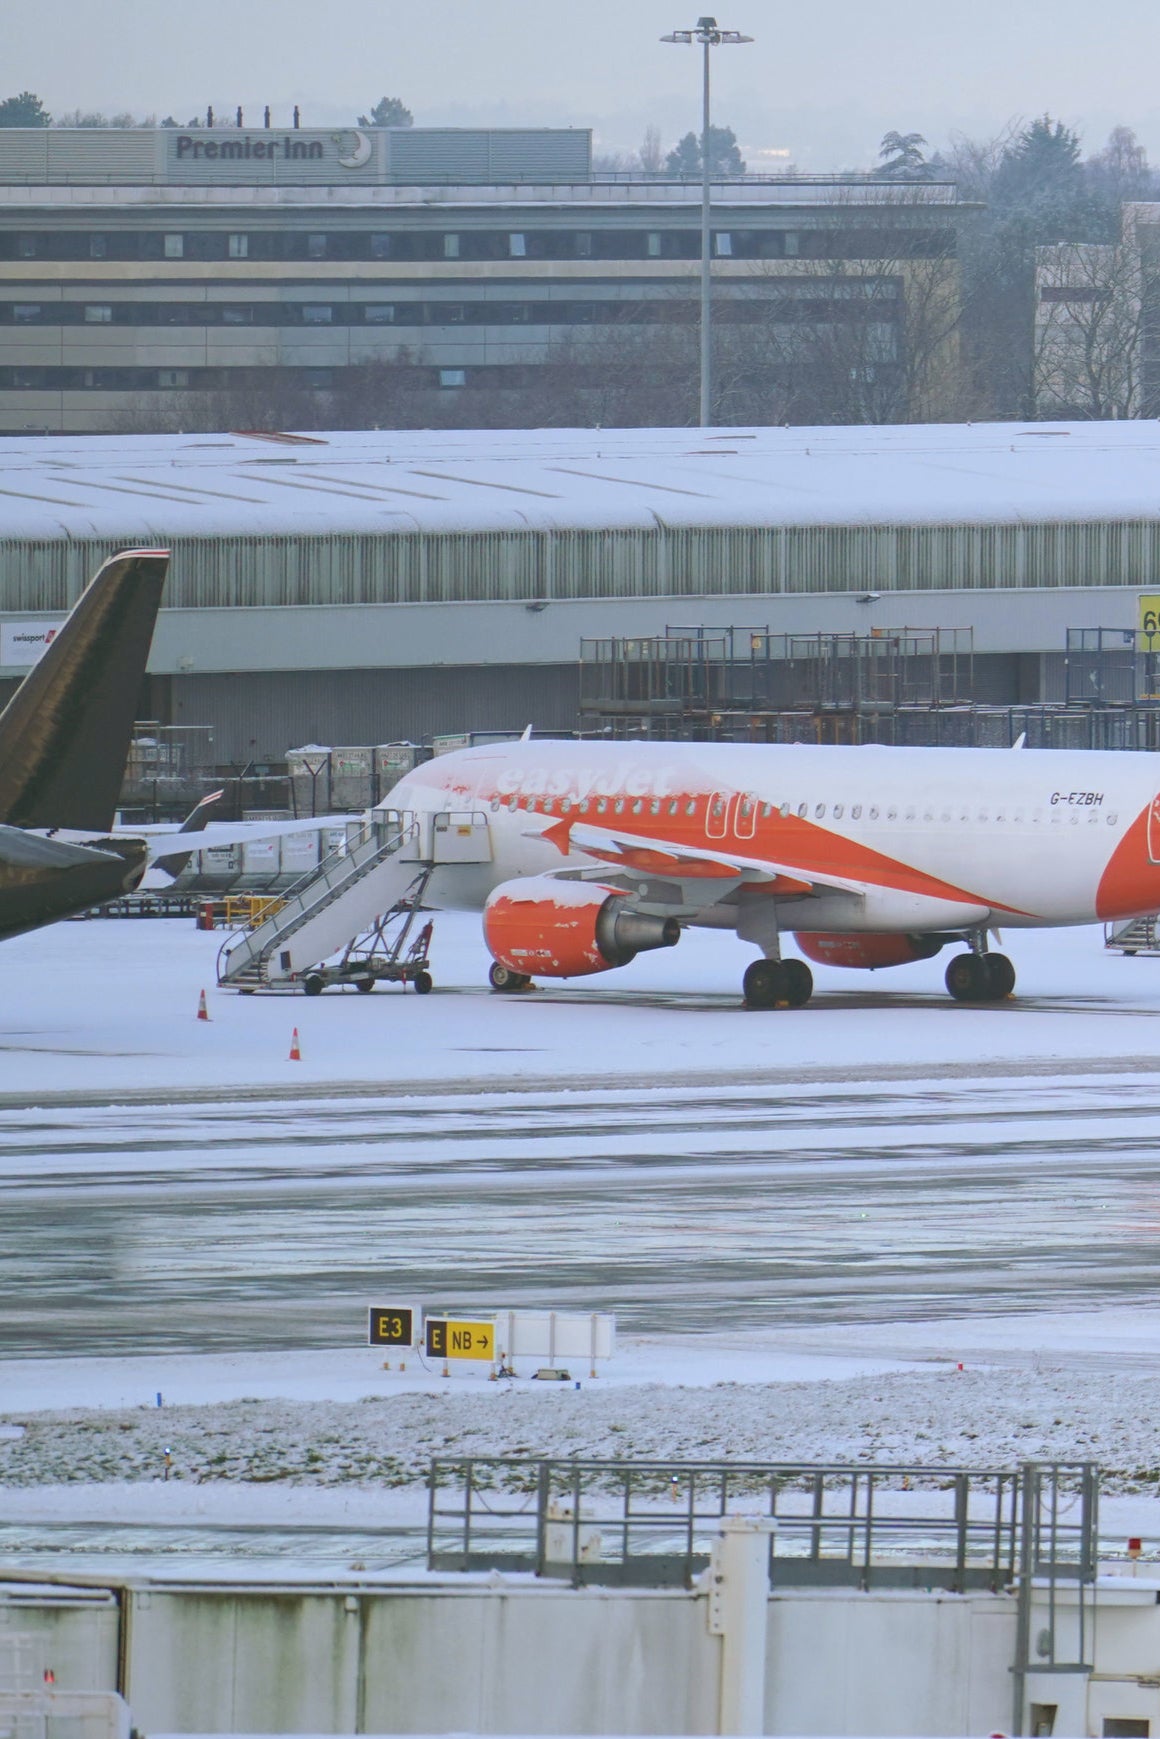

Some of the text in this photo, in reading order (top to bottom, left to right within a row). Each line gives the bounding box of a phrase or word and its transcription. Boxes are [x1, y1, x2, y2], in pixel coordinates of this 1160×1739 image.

[176, 136, 323, 159] Premier Inn
[13, 633, 45, 643] swissport
[496, 761, 675, 804] easyJet
[1050, 792, 1104, 806] G-EZBH
[379, 1316, 402, 1337] E3
[432, 1329, 472, 1350] E NB
